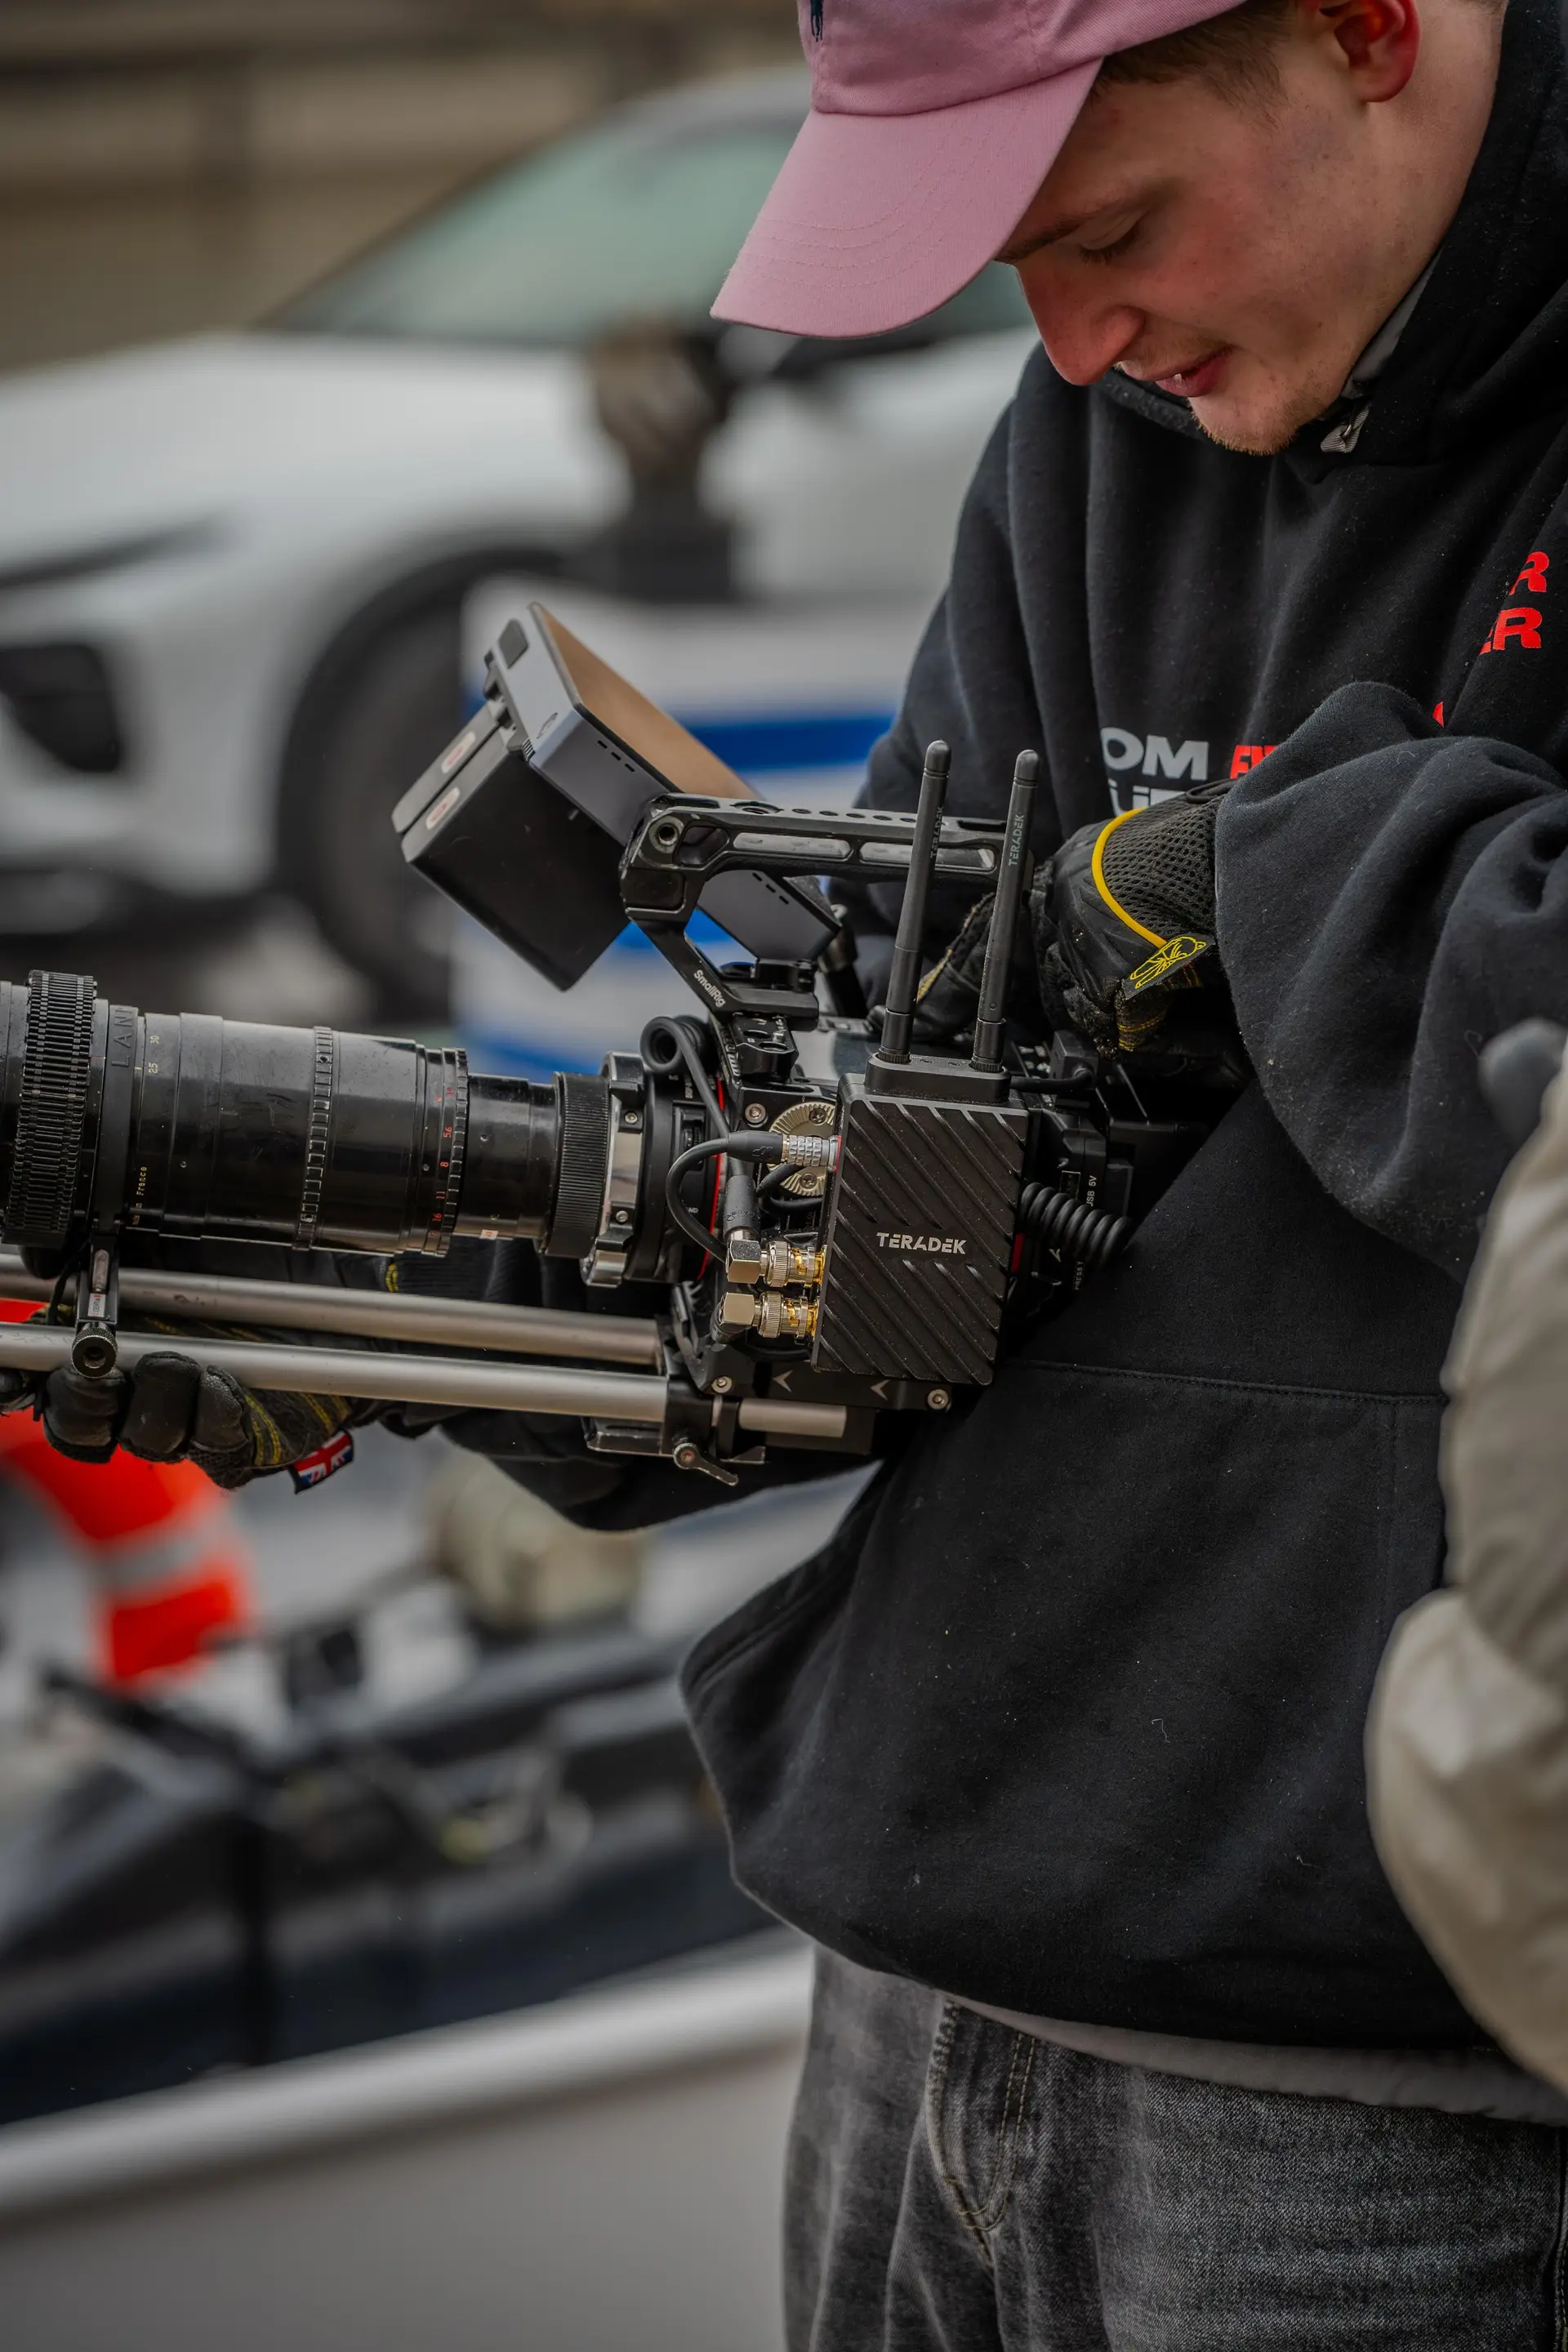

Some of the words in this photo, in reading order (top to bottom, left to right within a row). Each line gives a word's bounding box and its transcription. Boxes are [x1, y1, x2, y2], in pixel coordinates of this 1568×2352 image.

[1480, 608, 1542, 655] R
[930, 806, 944, 858] TERADEK
[1008, 814, 1024, 866] TERADEK
[694, 969, 726, 1008] SmallRig
[149, 1062, 158, 1074] 25
[1089, 1175, 1098, 1187] 5V
[431, 1213, 442, 1222] 16
[876, 1232, 967, 1254] TERADEK
[1074, 1267, 1084, 1290] PRESS
